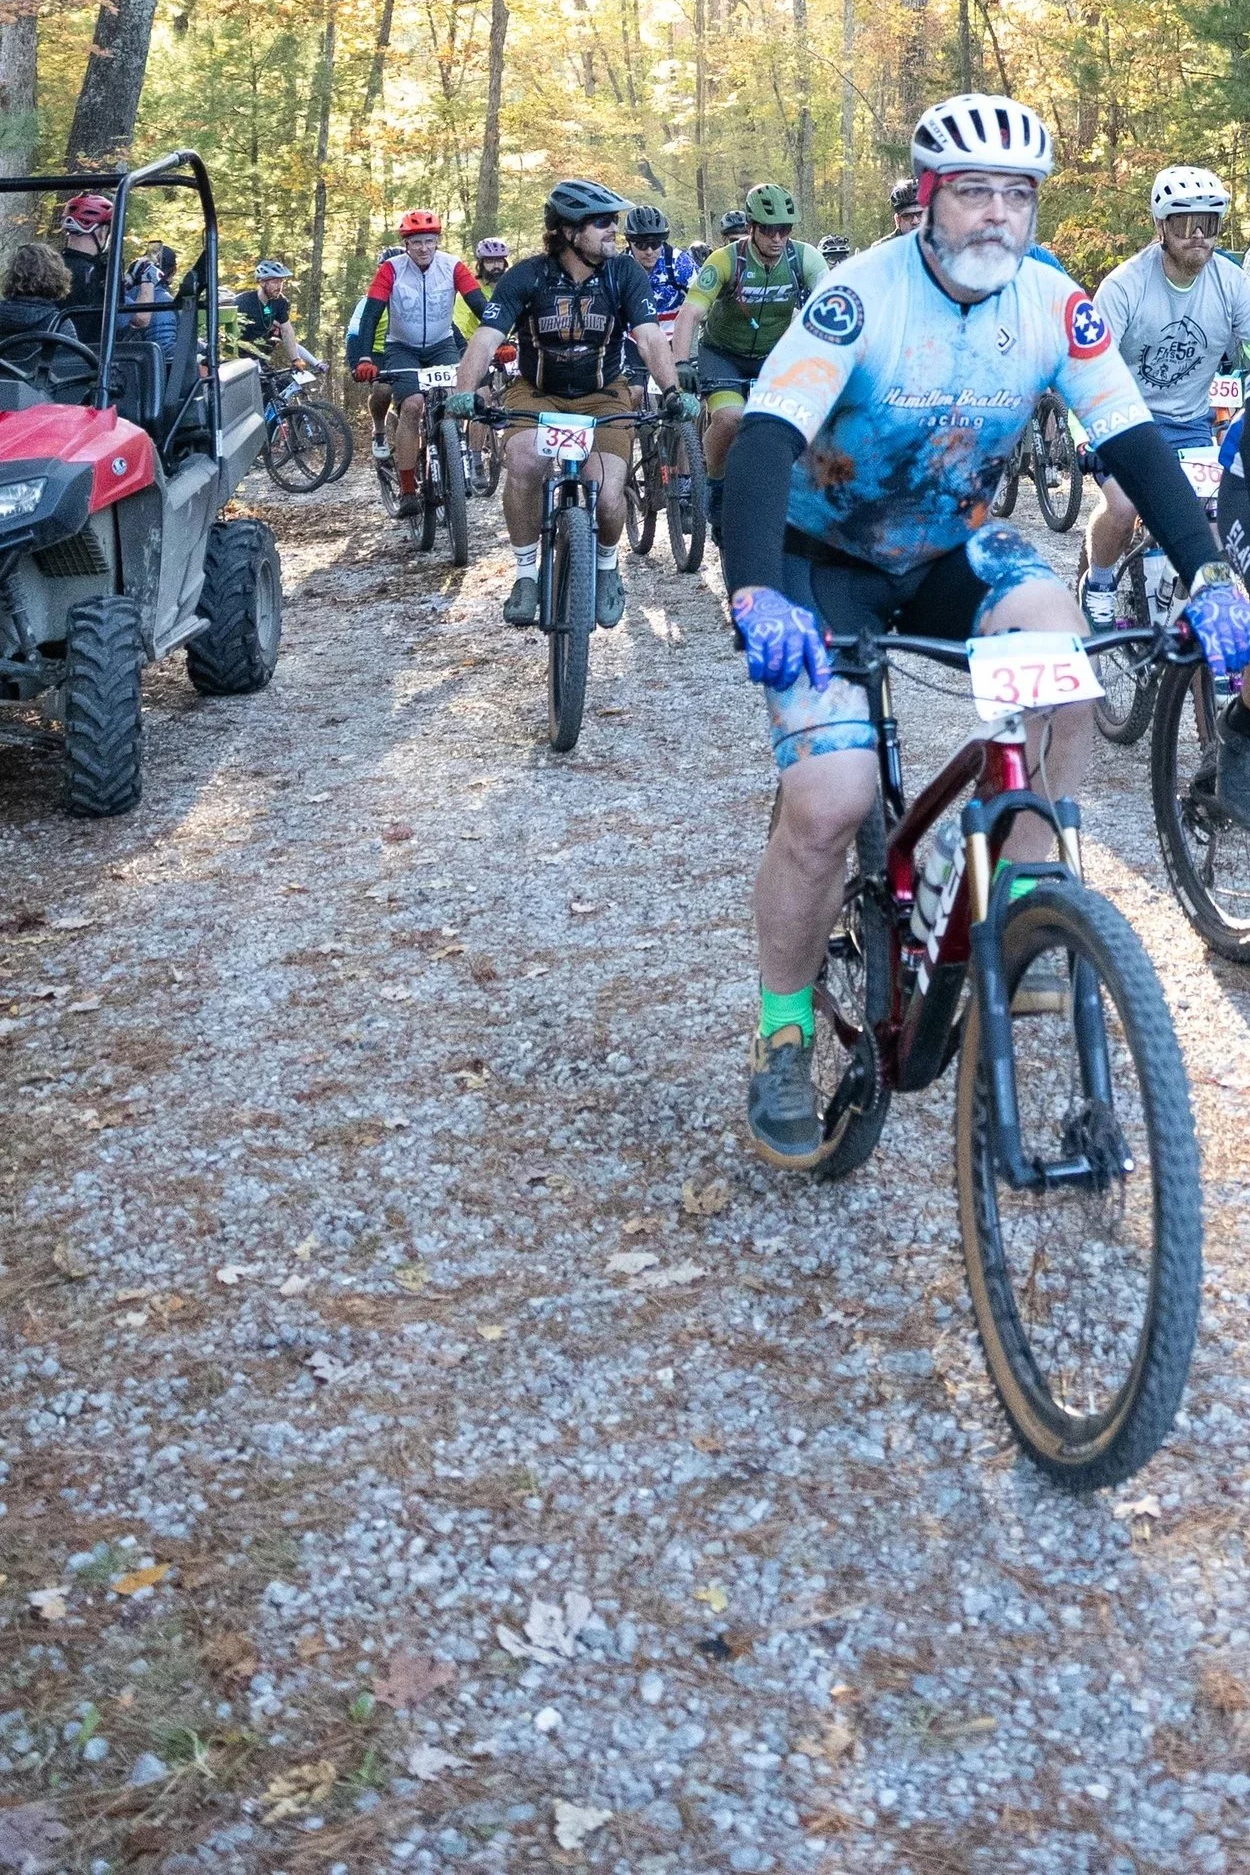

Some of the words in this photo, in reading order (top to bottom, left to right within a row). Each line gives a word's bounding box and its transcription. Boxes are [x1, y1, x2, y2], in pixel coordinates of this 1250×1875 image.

[425, 371, 451, 383] 166
[883, 386, 953, 409] Hamilton
[956, 389, 1021, 410] Bradley
[1209, 380, 1239, 398] 356
[751, 391, 812, 423] HUCK
[918, 414, 985, 429] racing
[545, 427, 588, 448] 324
[992, 663, 1080, 703] 375
